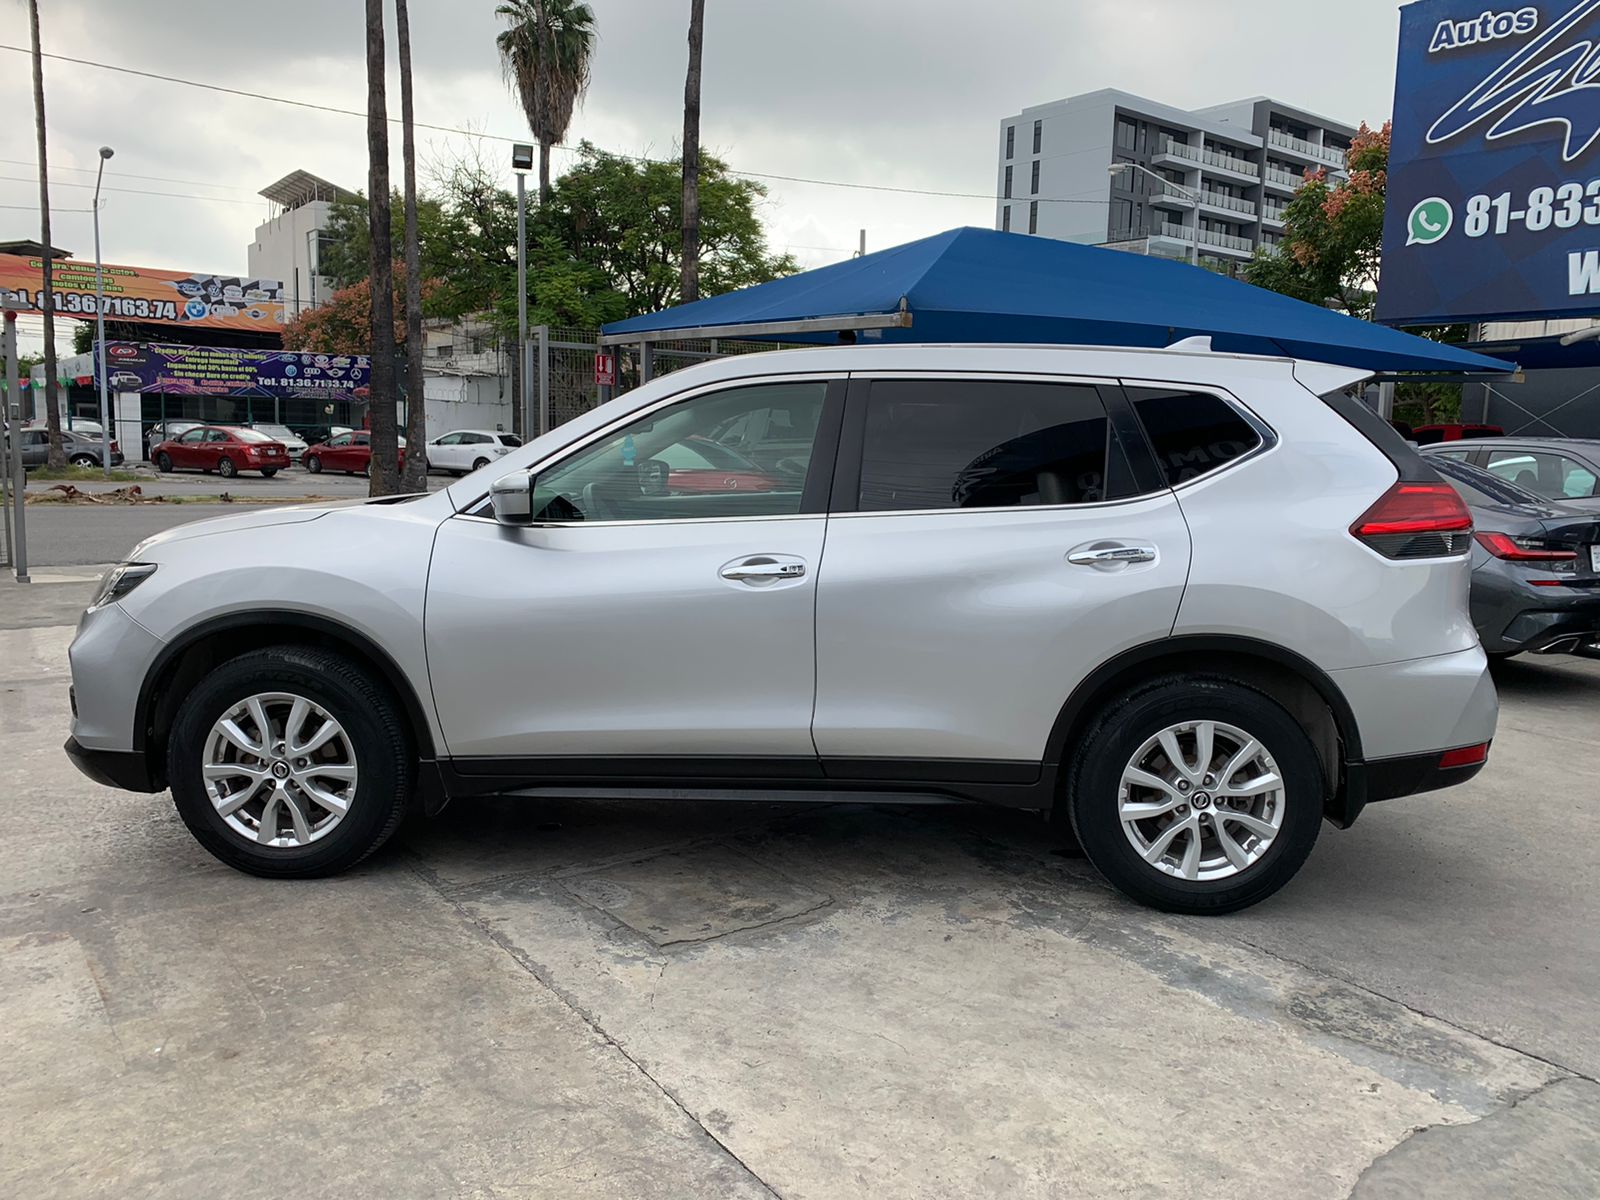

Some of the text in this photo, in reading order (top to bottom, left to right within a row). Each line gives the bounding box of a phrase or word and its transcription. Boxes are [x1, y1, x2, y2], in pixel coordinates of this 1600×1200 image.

[1429, 8, 1538, 52] Autos
[30, 261, 69, 271] Copra,
[87, 283, 123, 292] lachas
[257, 377, 278, 386] Tel.
